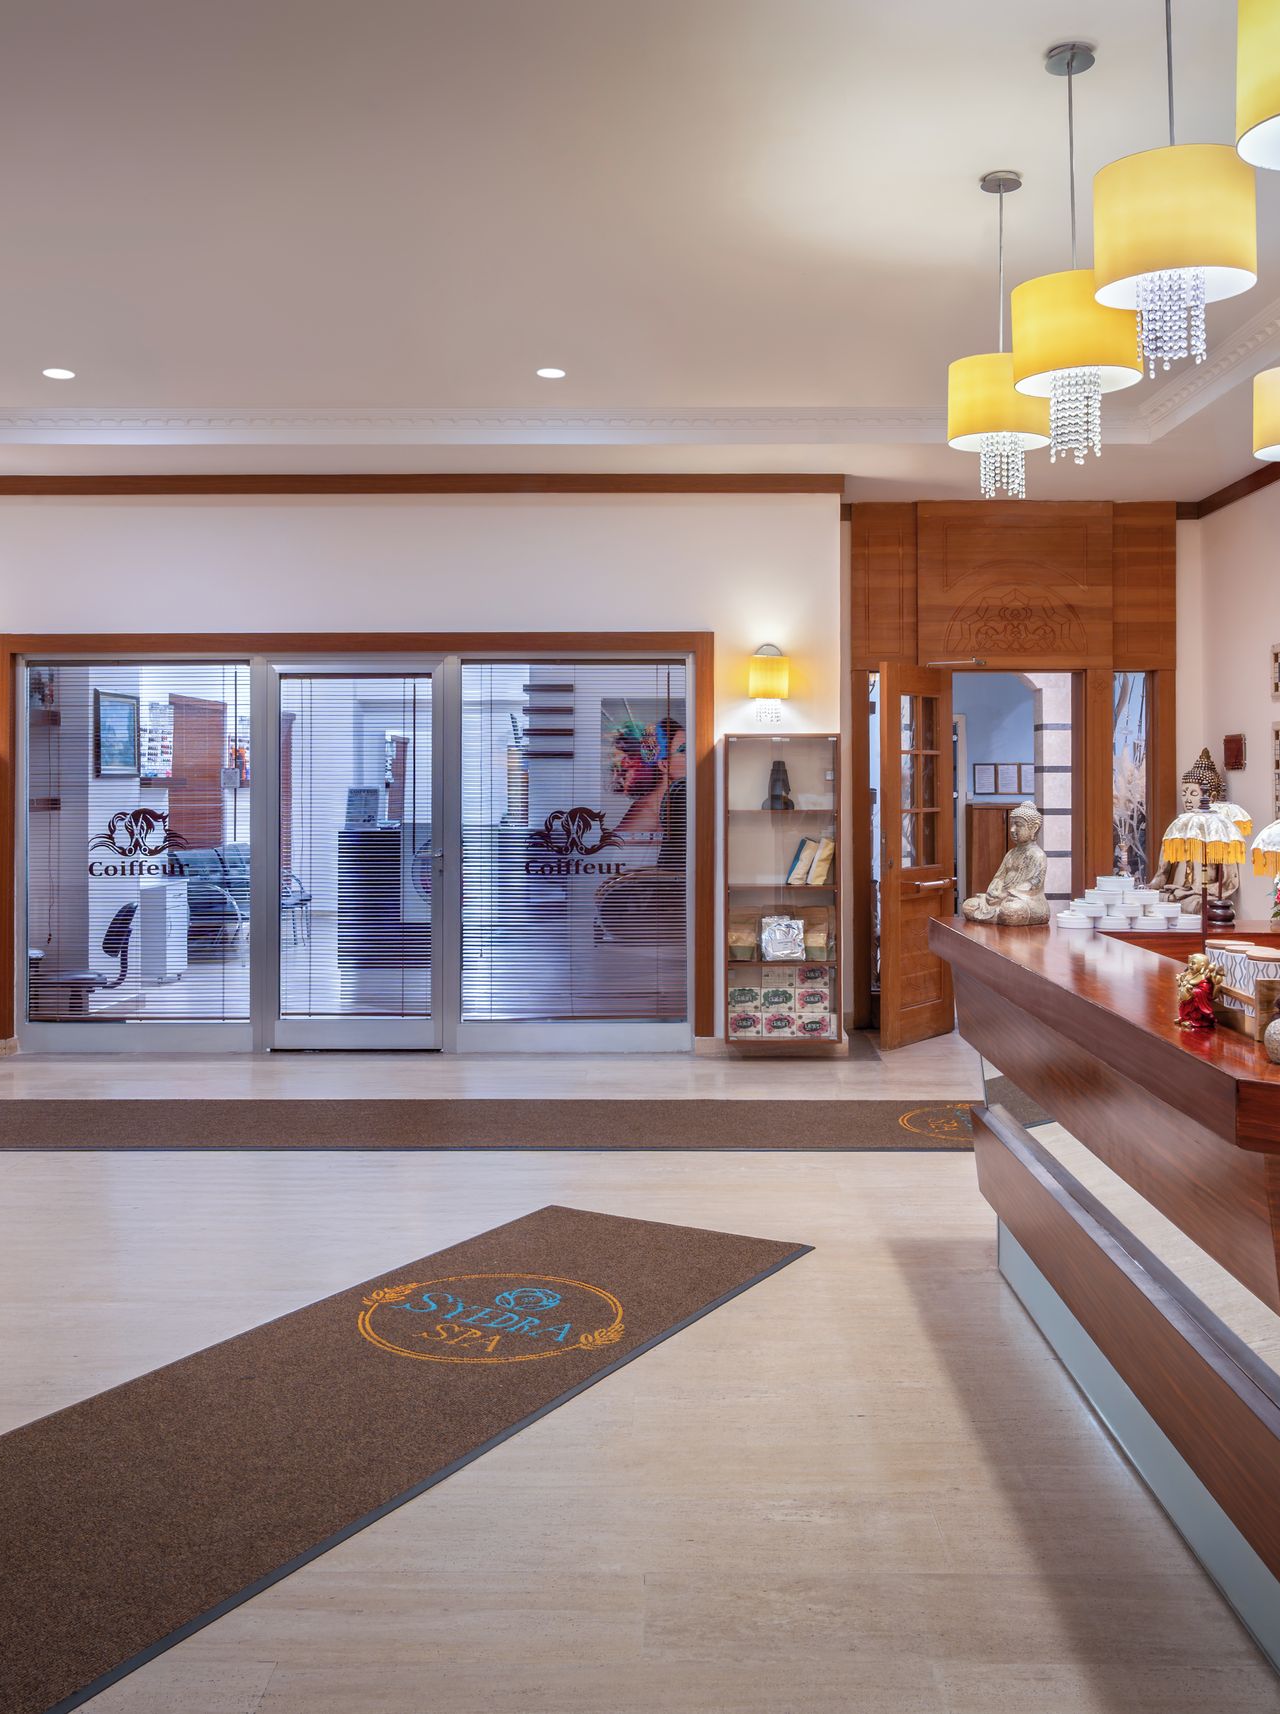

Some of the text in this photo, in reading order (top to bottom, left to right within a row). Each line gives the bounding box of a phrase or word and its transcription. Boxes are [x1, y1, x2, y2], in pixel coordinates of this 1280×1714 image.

[88, 860, 190, 876] Coiffeur
[524, 859, 626, 875] Coiffeur
[390, 1292, 571, 1342] SYEDRA
[412, 1323, 502, 1352] SPA
